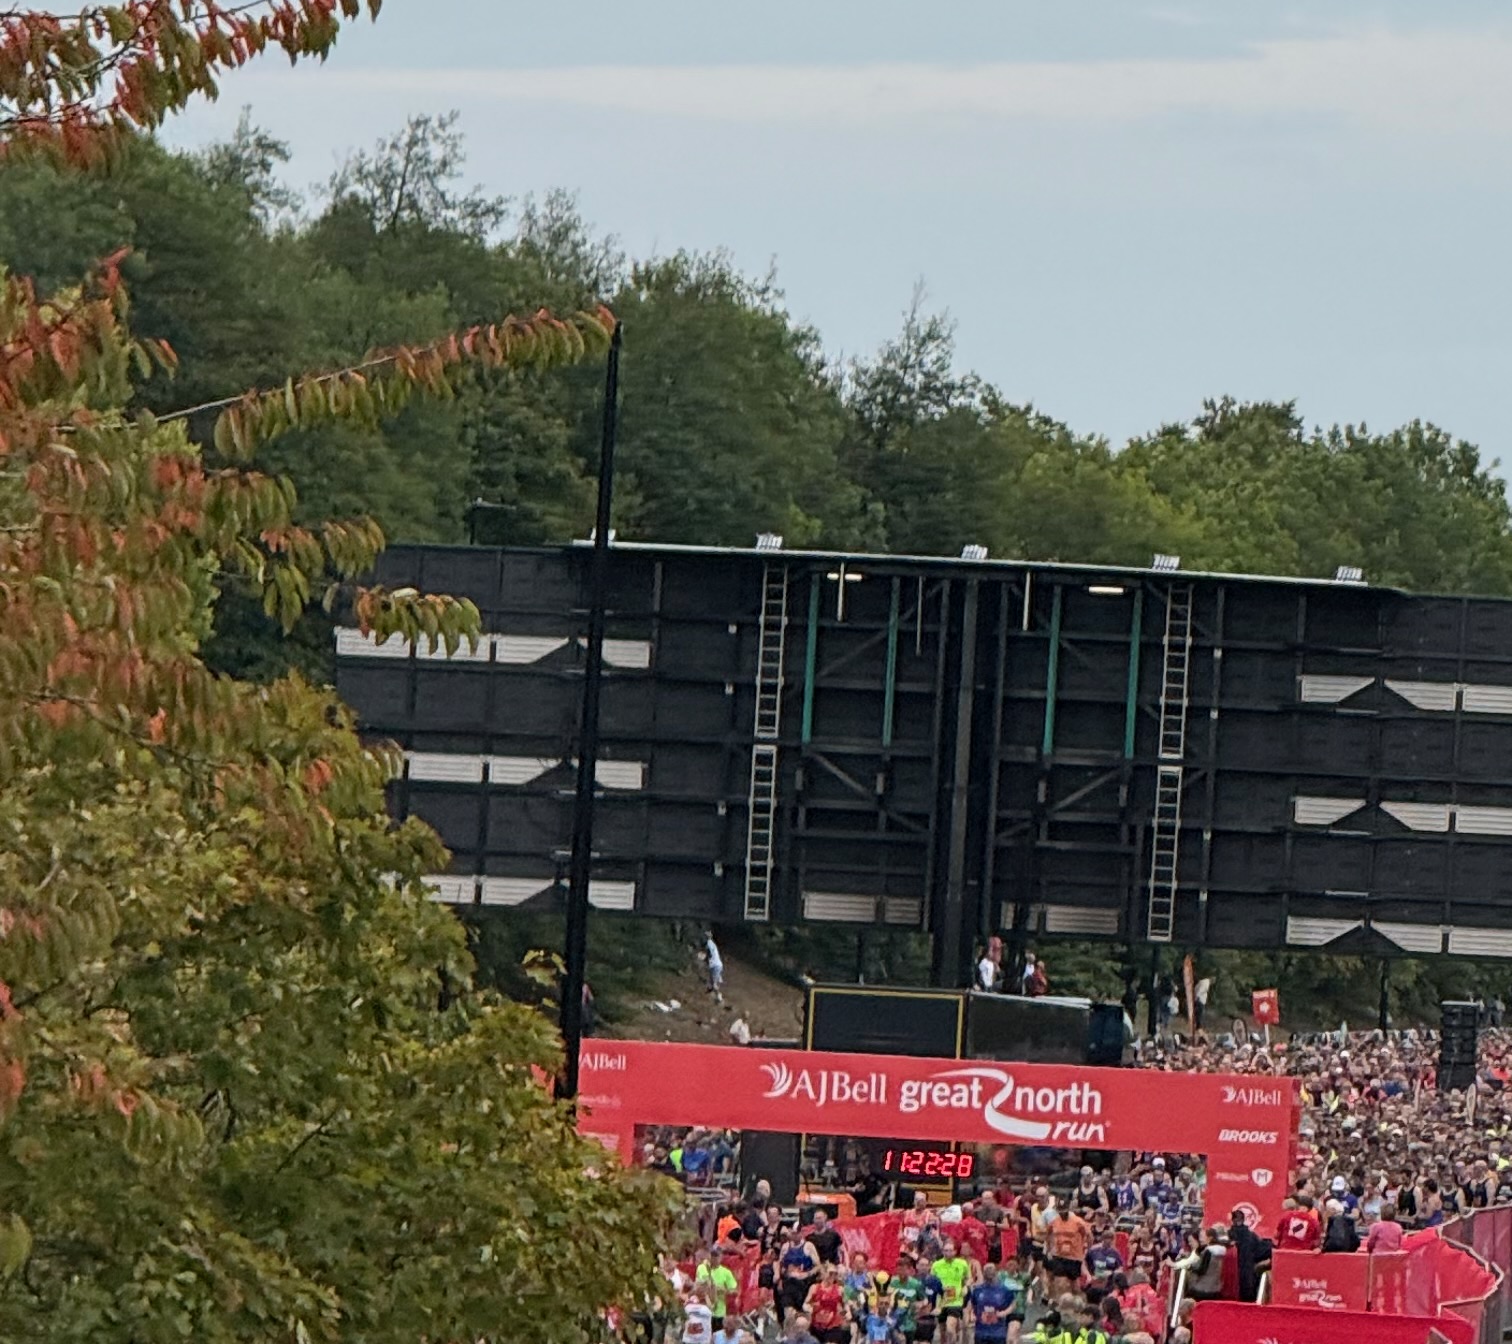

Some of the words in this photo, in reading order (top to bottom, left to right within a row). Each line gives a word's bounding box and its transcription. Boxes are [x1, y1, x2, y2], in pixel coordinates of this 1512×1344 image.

[579, 1052, 627, 1071] AJBell
[790, 1069, 887, 1106] AJBell
[900, 1077, 983, 1113] great
[1015, 1080, 1101, 1115] north
[1236, 1087, 1281, 1106] AJBell
[1051, 1119, 1105, 1142] run
[1217, 1128, 1279, 1144] BROOKS
[884, 1150, 973, 1177] 11:22:28
